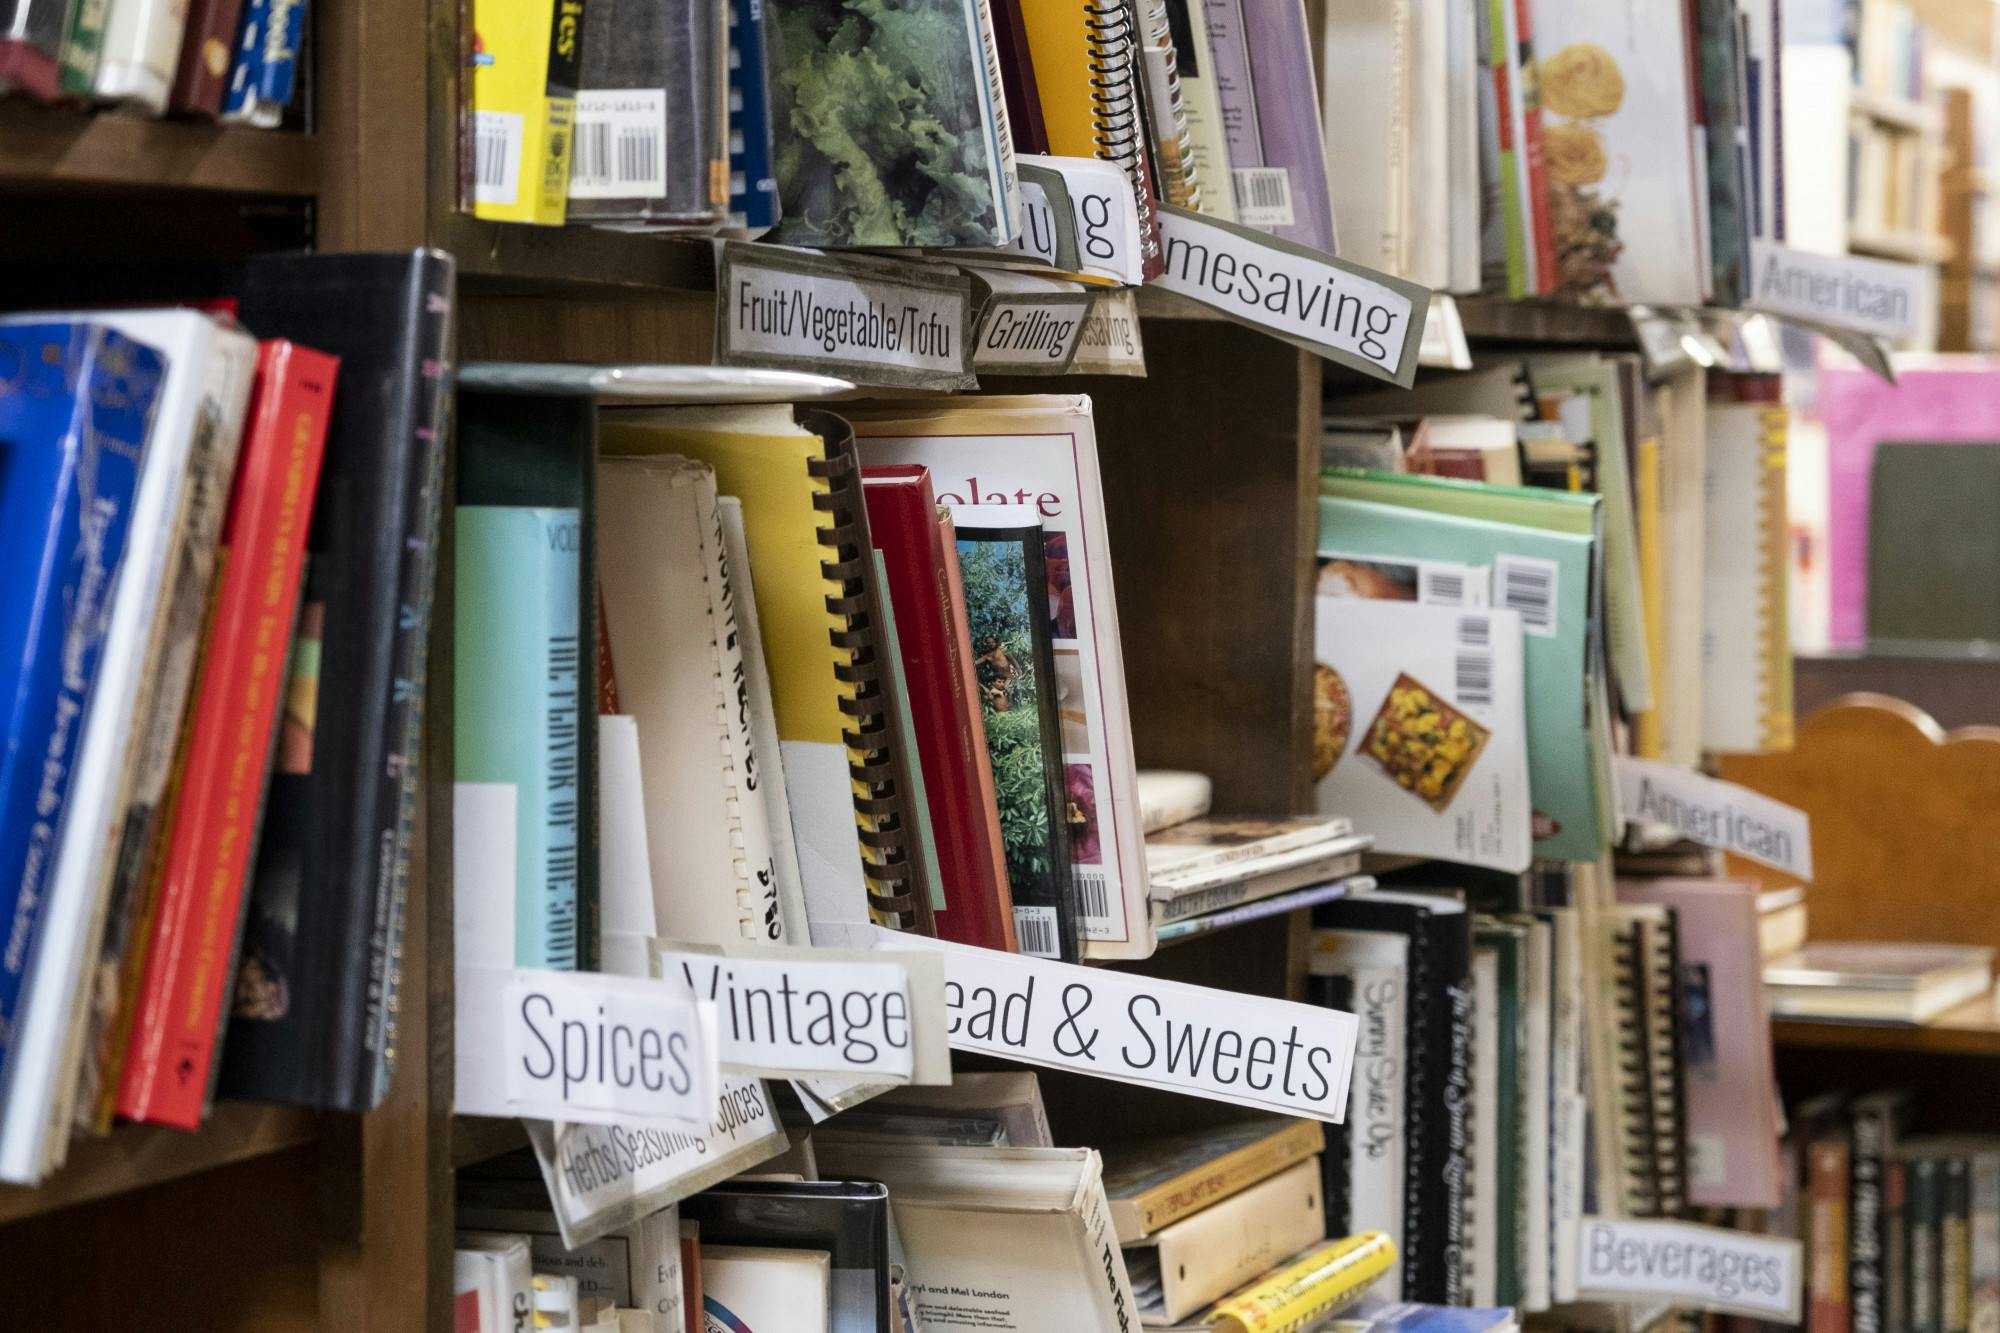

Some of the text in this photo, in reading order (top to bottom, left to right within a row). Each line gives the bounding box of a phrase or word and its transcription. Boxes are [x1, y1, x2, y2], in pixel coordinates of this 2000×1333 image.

[982, 32, 999, 103] RANDOM
[996, 111, 1011, 163] HOUSE
[738, 281, 950, 359] Fruit/Vegetable/Tofu
[1164, 234, 1398, 362] mesaving
[1760, 255, 1909, 323] American
[987, 308, 1075, 358] Grilling
[1080, 316, 1134, 356] esaving
[1637, 779, 1795, 864] American
[544, 902, 576, 971] SOUT
[520, 992, 692, 1101] Spices
[682, 961, 909, 1064] Vintage
[944, 975, 1332, 1102] ead & Sweets
[1360, 1122, 1395, 1161] Up
[928, 1286, 948, 1294] and
[951, 1287, 970, 1296] Mel
[972, 1289, 1010, 1299] London
[1102, 1242, 1117, 1294] The
[1588, 1225, 1782, 1296] Beverages
